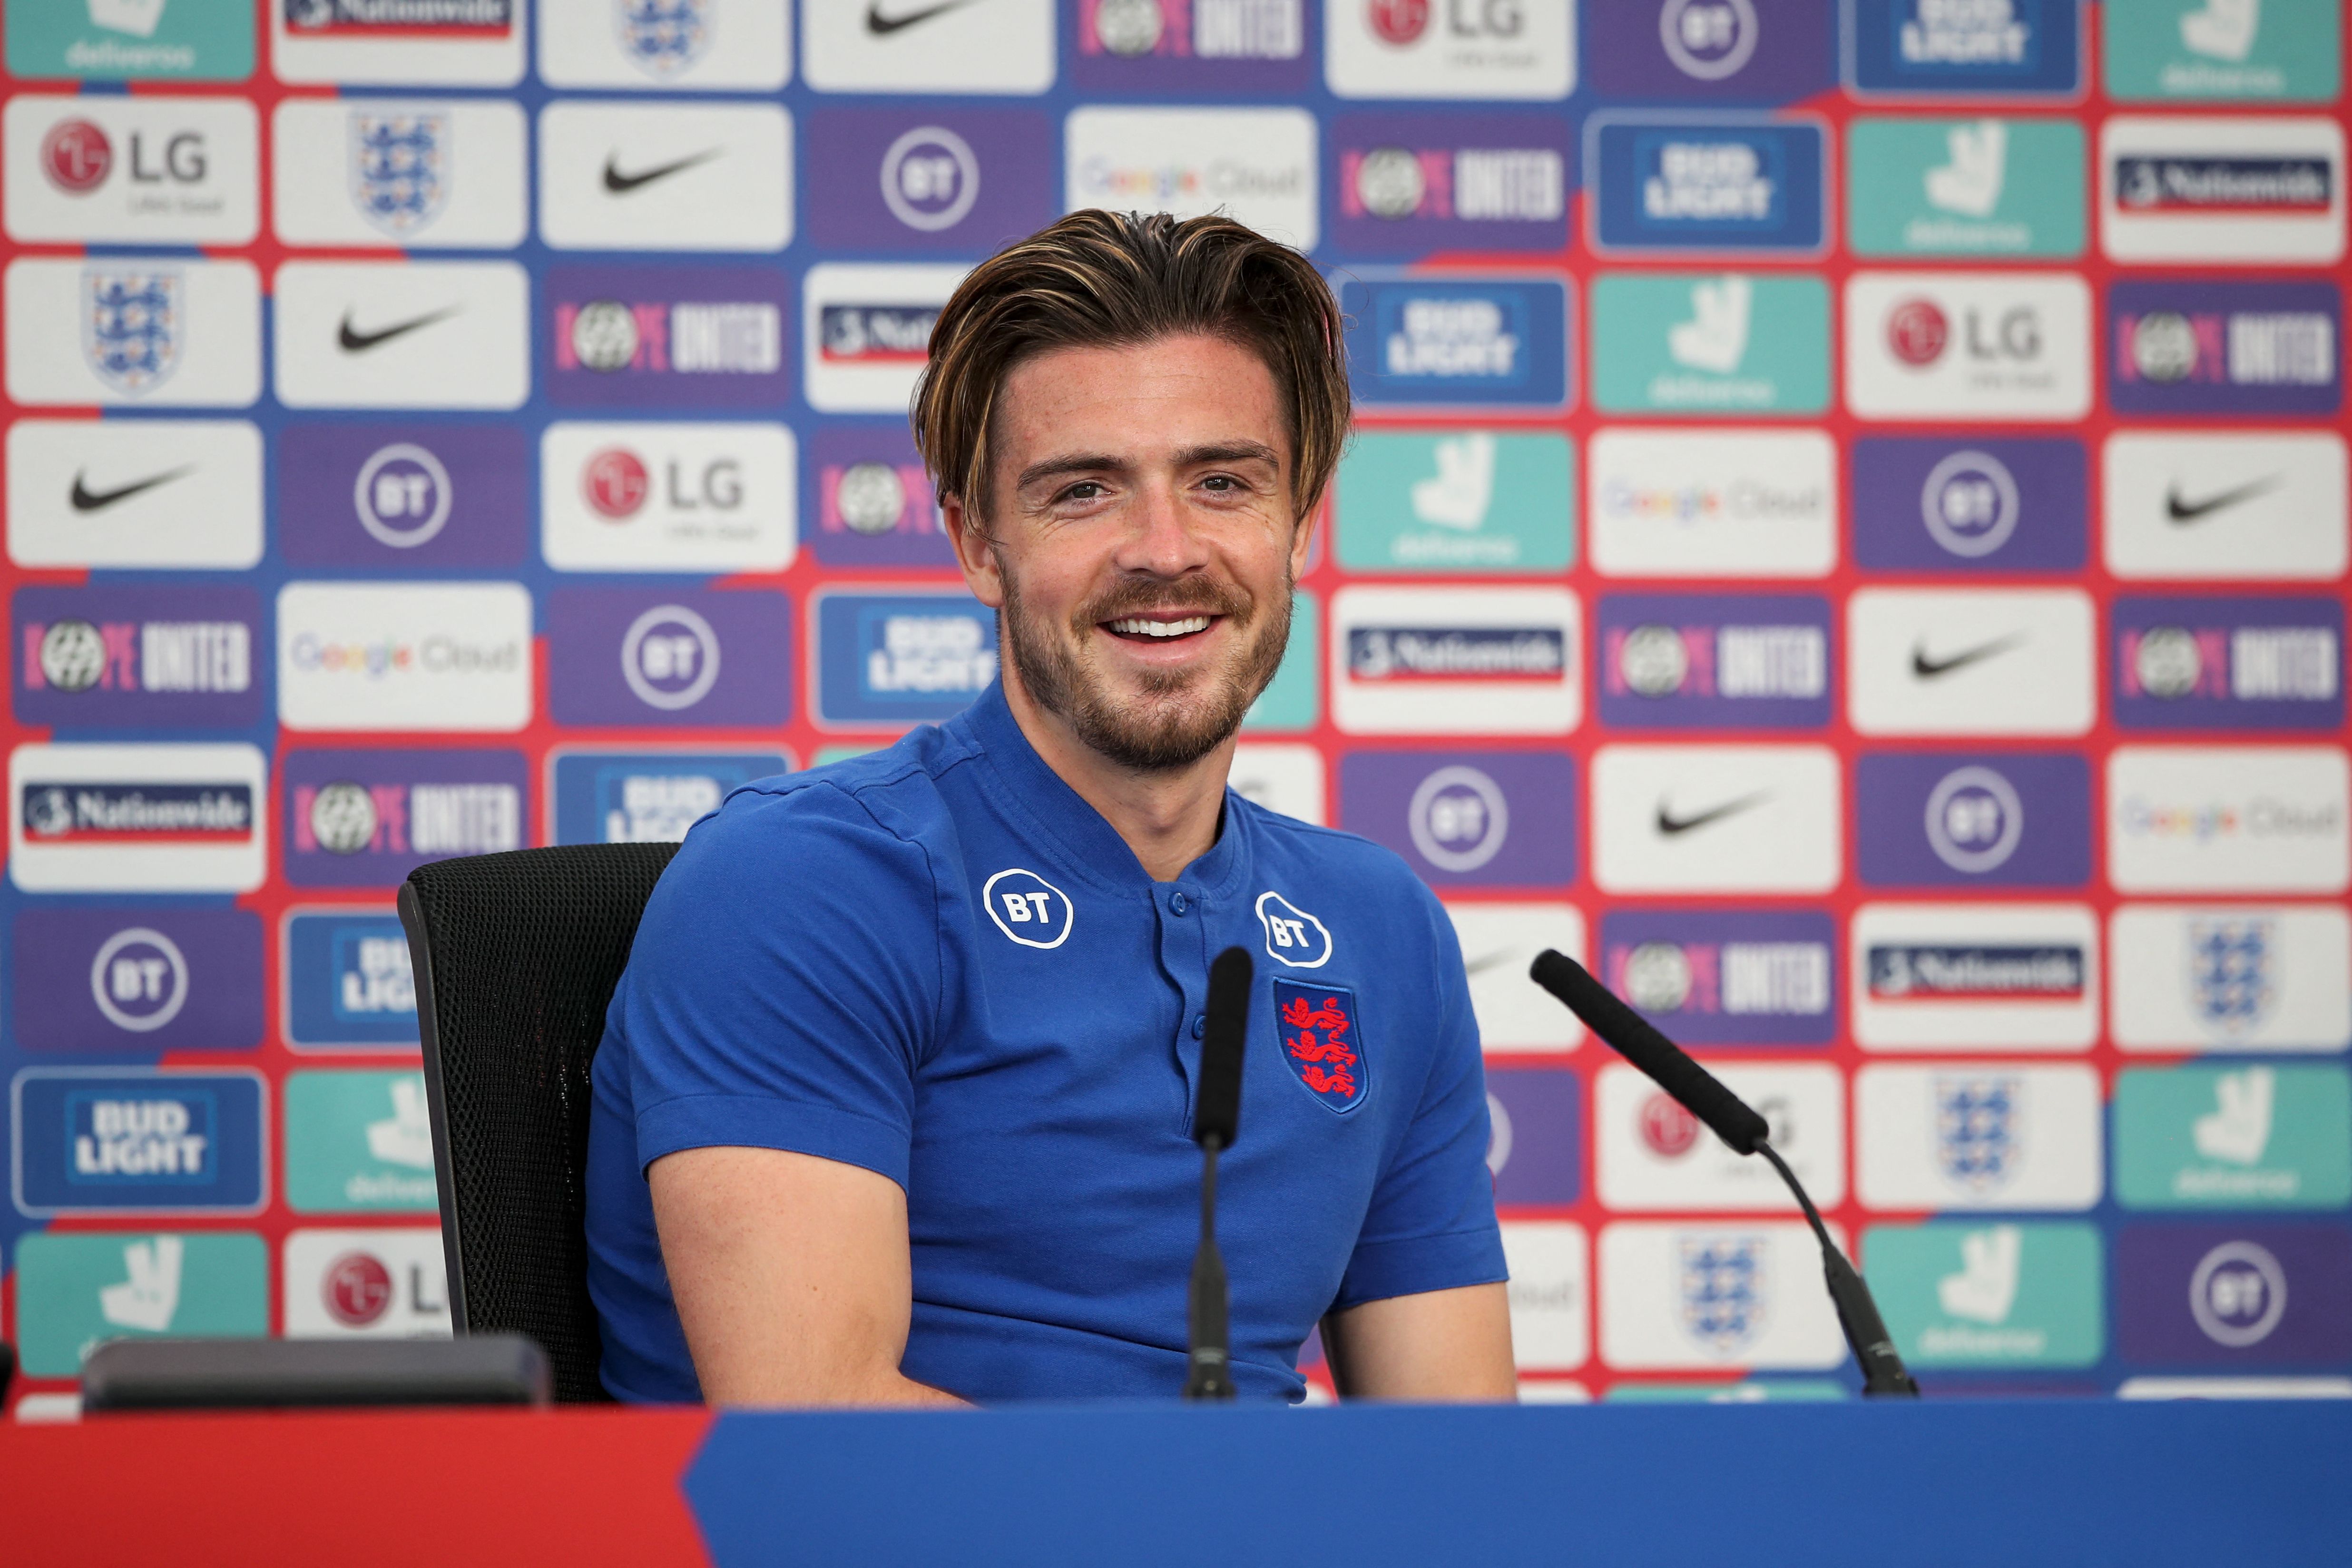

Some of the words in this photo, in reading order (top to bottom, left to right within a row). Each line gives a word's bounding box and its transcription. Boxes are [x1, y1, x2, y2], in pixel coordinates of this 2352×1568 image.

[130, 132, 207, 184] LG
[899, 155, 954, 201] BT
[1965, 306, 2044, 363] LG
[374, 473, 428, 518] BT
[666, 458, 744, 511] LG
[142, 623, 250, 691] UNITED
[641, 635, 698, 680] BT
[76, 790, 247, 829] Nationwide
[410, 784, 519, 853] UNITED
[1001, 892, 1049, 924] BT
[1269, 915, 1309, 947] BT
[111, 958, 167, 1001] BT
[92, 1100, 189, 1136] BUD
[75, 1135, 208, 1174] LIGHT
